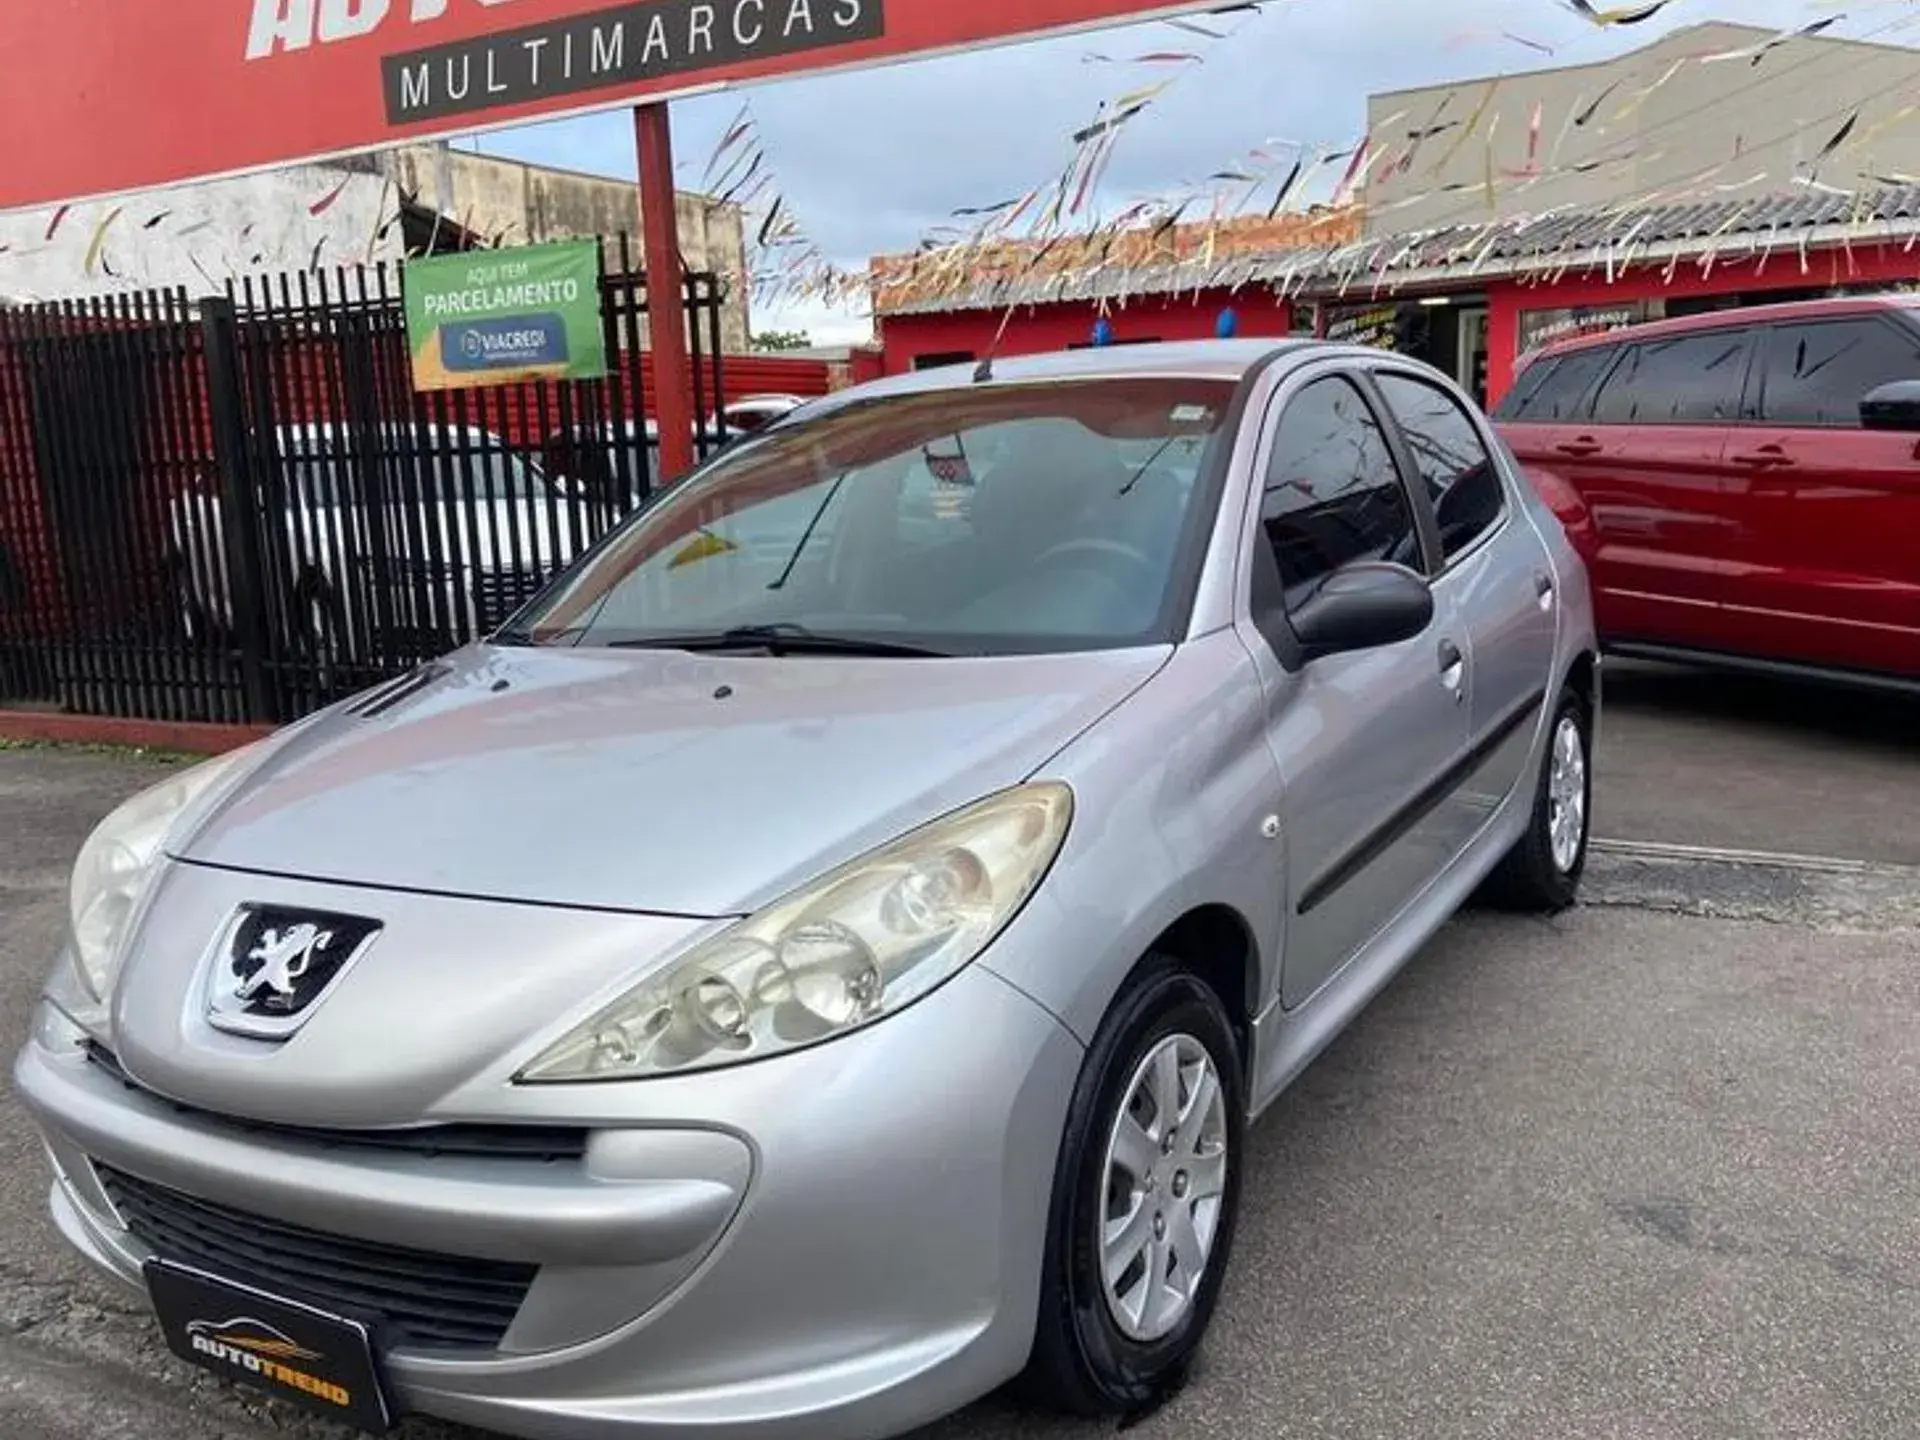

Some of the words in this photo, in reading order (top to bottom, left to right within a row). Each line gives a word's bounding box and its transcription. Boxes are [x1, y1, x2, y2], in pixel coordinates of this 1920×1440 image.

[401, 0, 861, 109] MULTIMARCAS
[466, 266, 498, 286] AQUI
[500, 262, 529, 282] TEM
[424, 278, 578, 315] PARCELAMENTO
